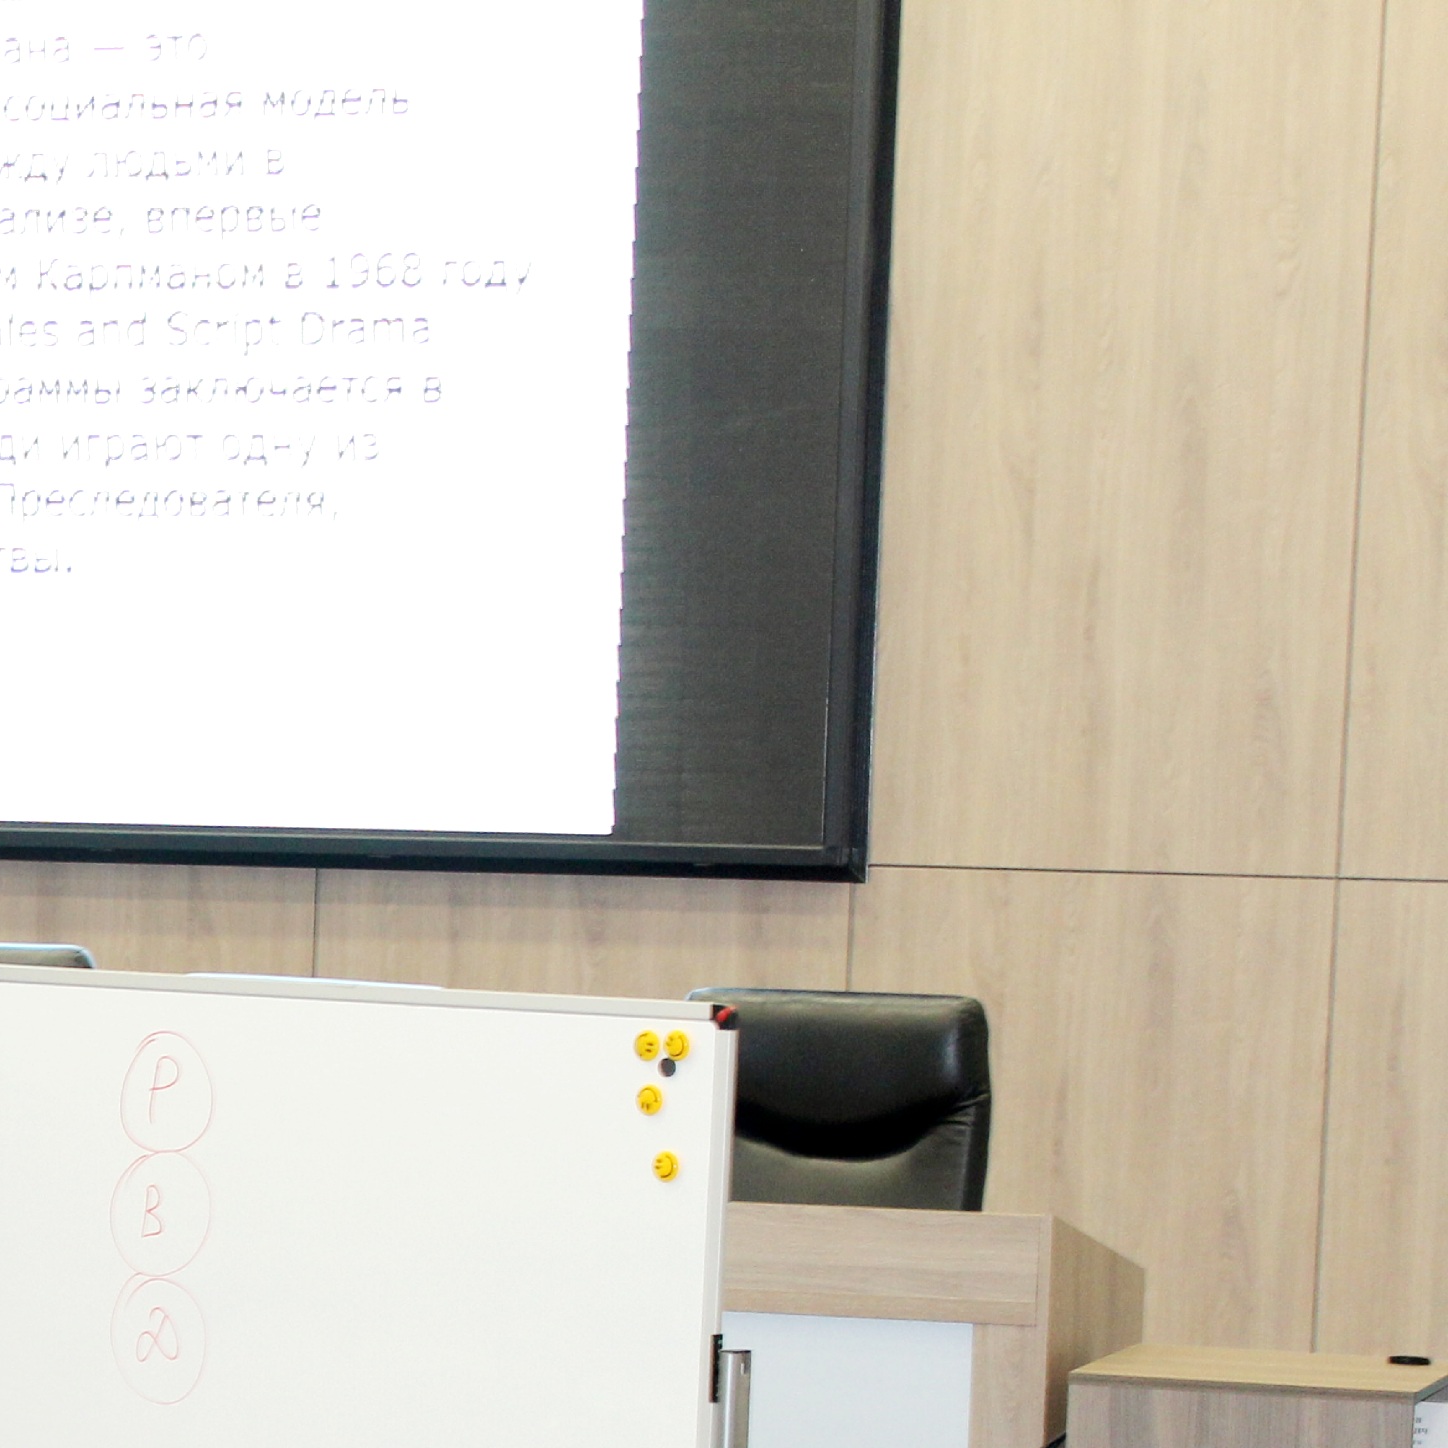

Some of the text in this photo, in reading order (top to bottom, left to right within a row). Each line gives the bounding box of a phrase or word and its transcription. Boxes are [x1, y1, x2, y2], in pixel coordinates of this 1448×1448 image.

[145, 32, 206, 62] это
[3, 91, 243, 122] социальная
[262, 88, 409, 120] модель
[87, 150, 244, 182] людьми
[265, 148, 285, 176] в
[146, 204, 321, 239] впервые
[36, 258, 265, 294] Карпманом
[284, 262, 304, 290] в
[325, 252, 423, 290] 1968
[442, 260, 533, 294] году
[78, 311, 147, 347] and
[166, 310, 282, 357] Script
[300, 311, 430, 346] Drama
[141, 375, 403, 405] заключается
[422, 376, 443, 404] в
[62, 434, 204, 469] играют
[222, 434, 316, 467] одну
[337, 433, 380, 461] из
